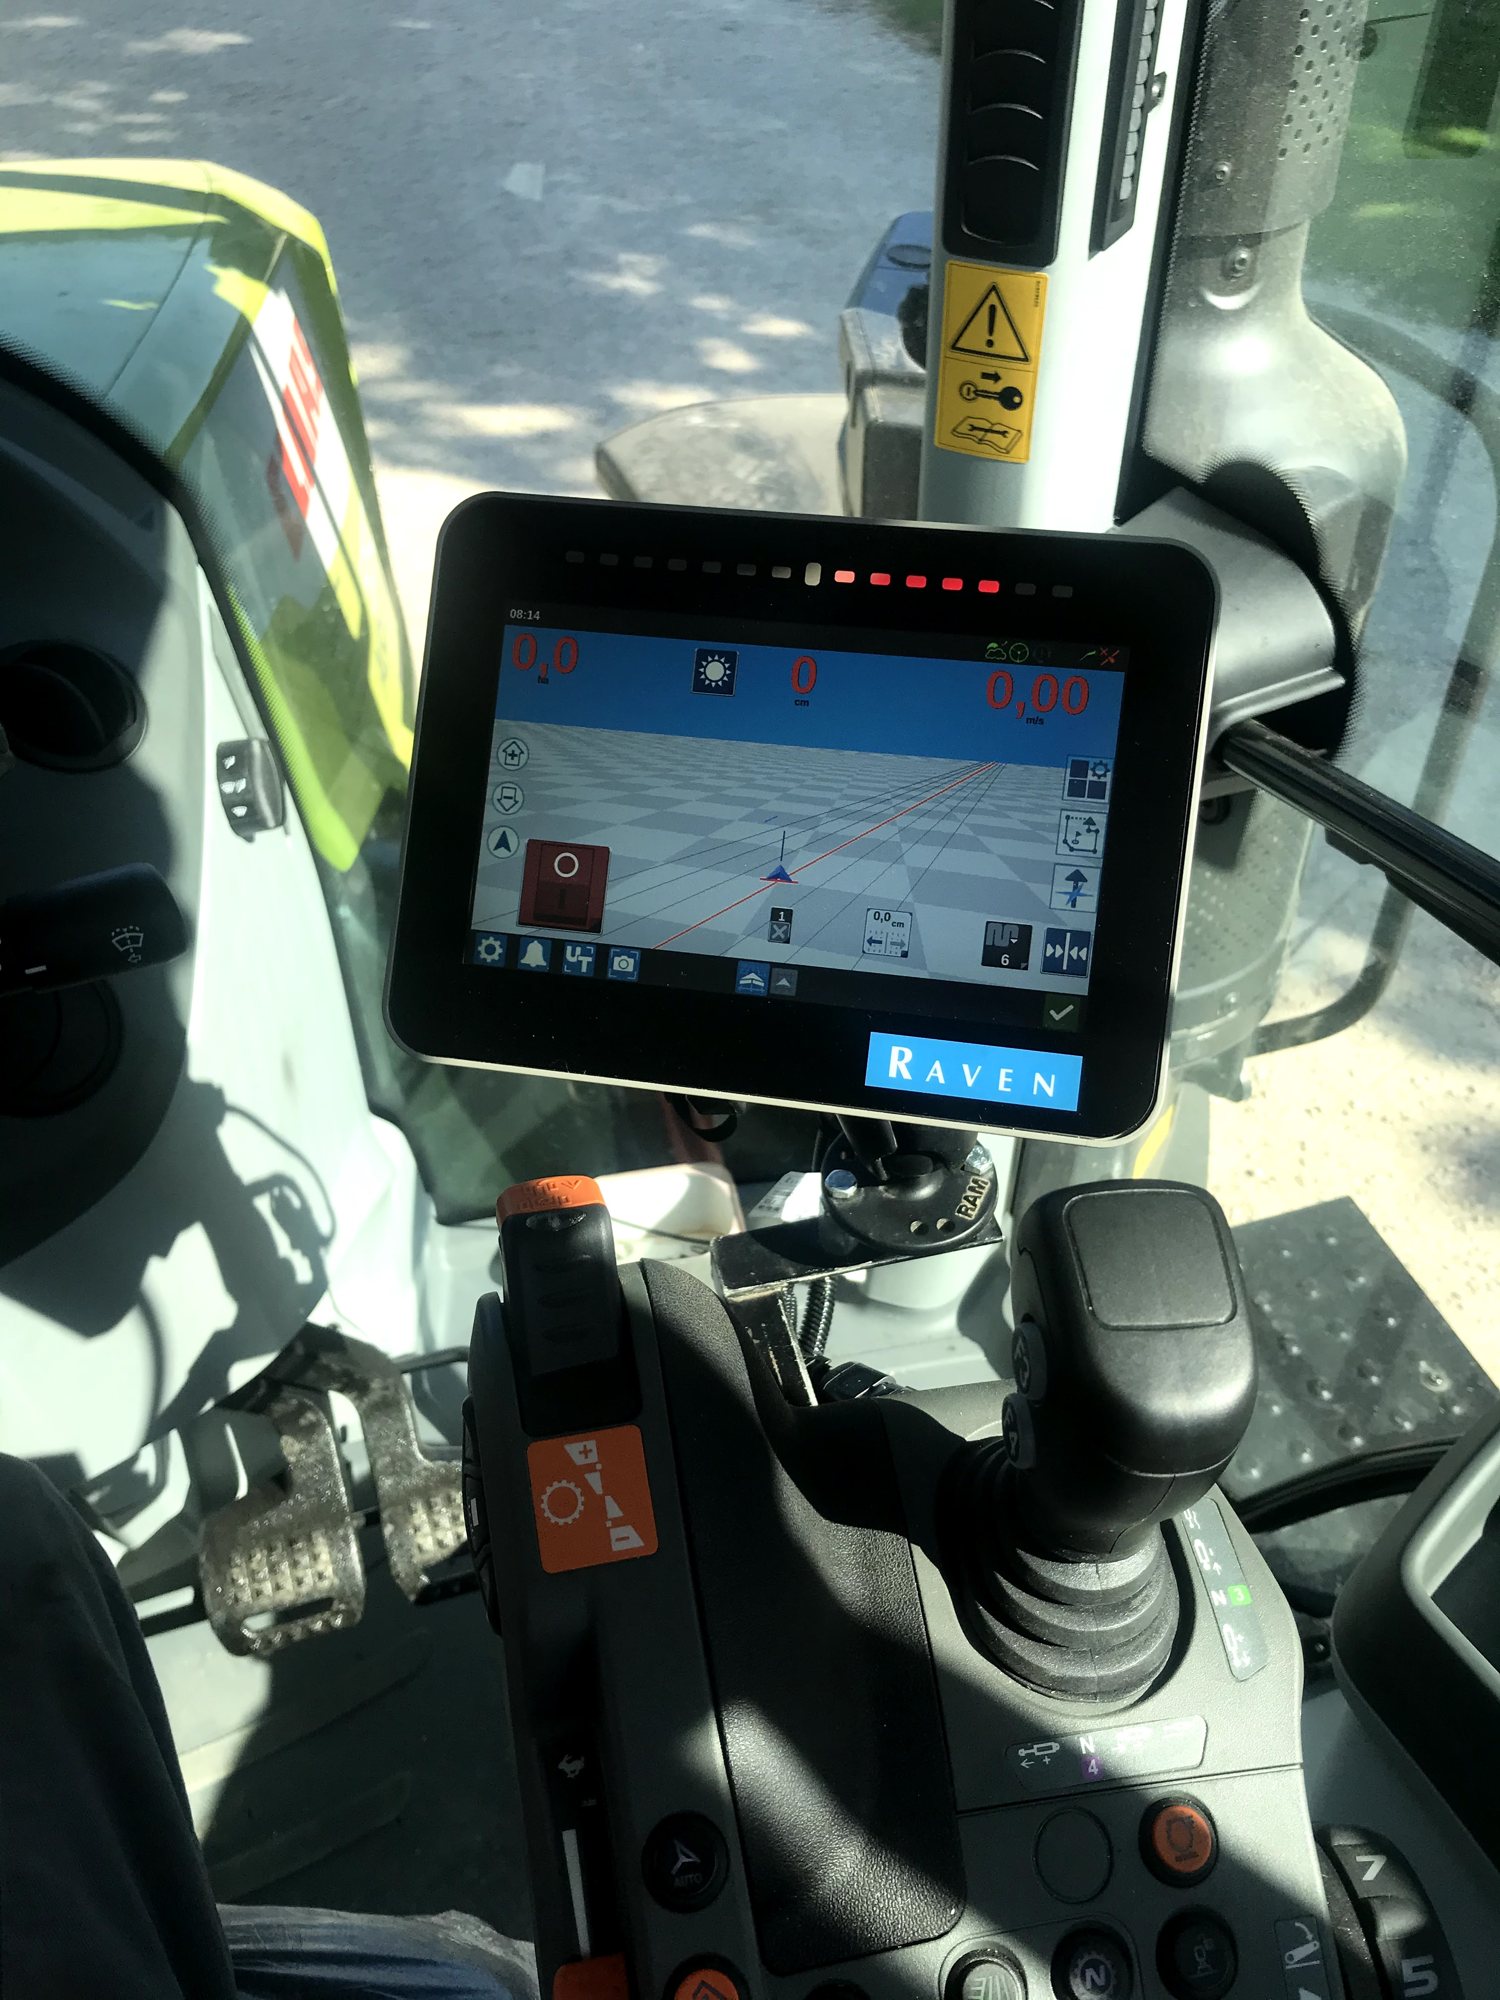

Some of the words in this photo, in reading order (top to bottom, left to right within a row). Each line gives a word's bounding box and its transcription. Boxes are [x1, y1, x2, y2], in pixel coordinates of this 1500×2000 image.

[509, 609, 540, 620] 08:14
[512, 632, 579, 680] 0,0
[791, 655, 817, 694] 0
[794, 699, 809, 707] cm
[986, 670, 1089, 719] 0,00
[1026, 716, 1044, 725] m/s
[778, 911, 785, 921] 1
[873, 911, 891, 923] 0,0
[891, 920, 905, 928] cm
[1001, 954, 1010, 966] 6
[888, 1045, 1056, 1098] RAVEN
[955, 1176, 990, 1220] RAM
[1211, 1589, 1227, 1606] N
[1233, 1587, 1245, 1601] 3
[1079, 1735, 1095, 1754] N
[1088, 1759, 1099, 1775] 4
[1355, 1855, 1388, 1881] 7
[1085, 1965, 1106, 1990] N
[1400, 1954, 1439, 1998] 5
